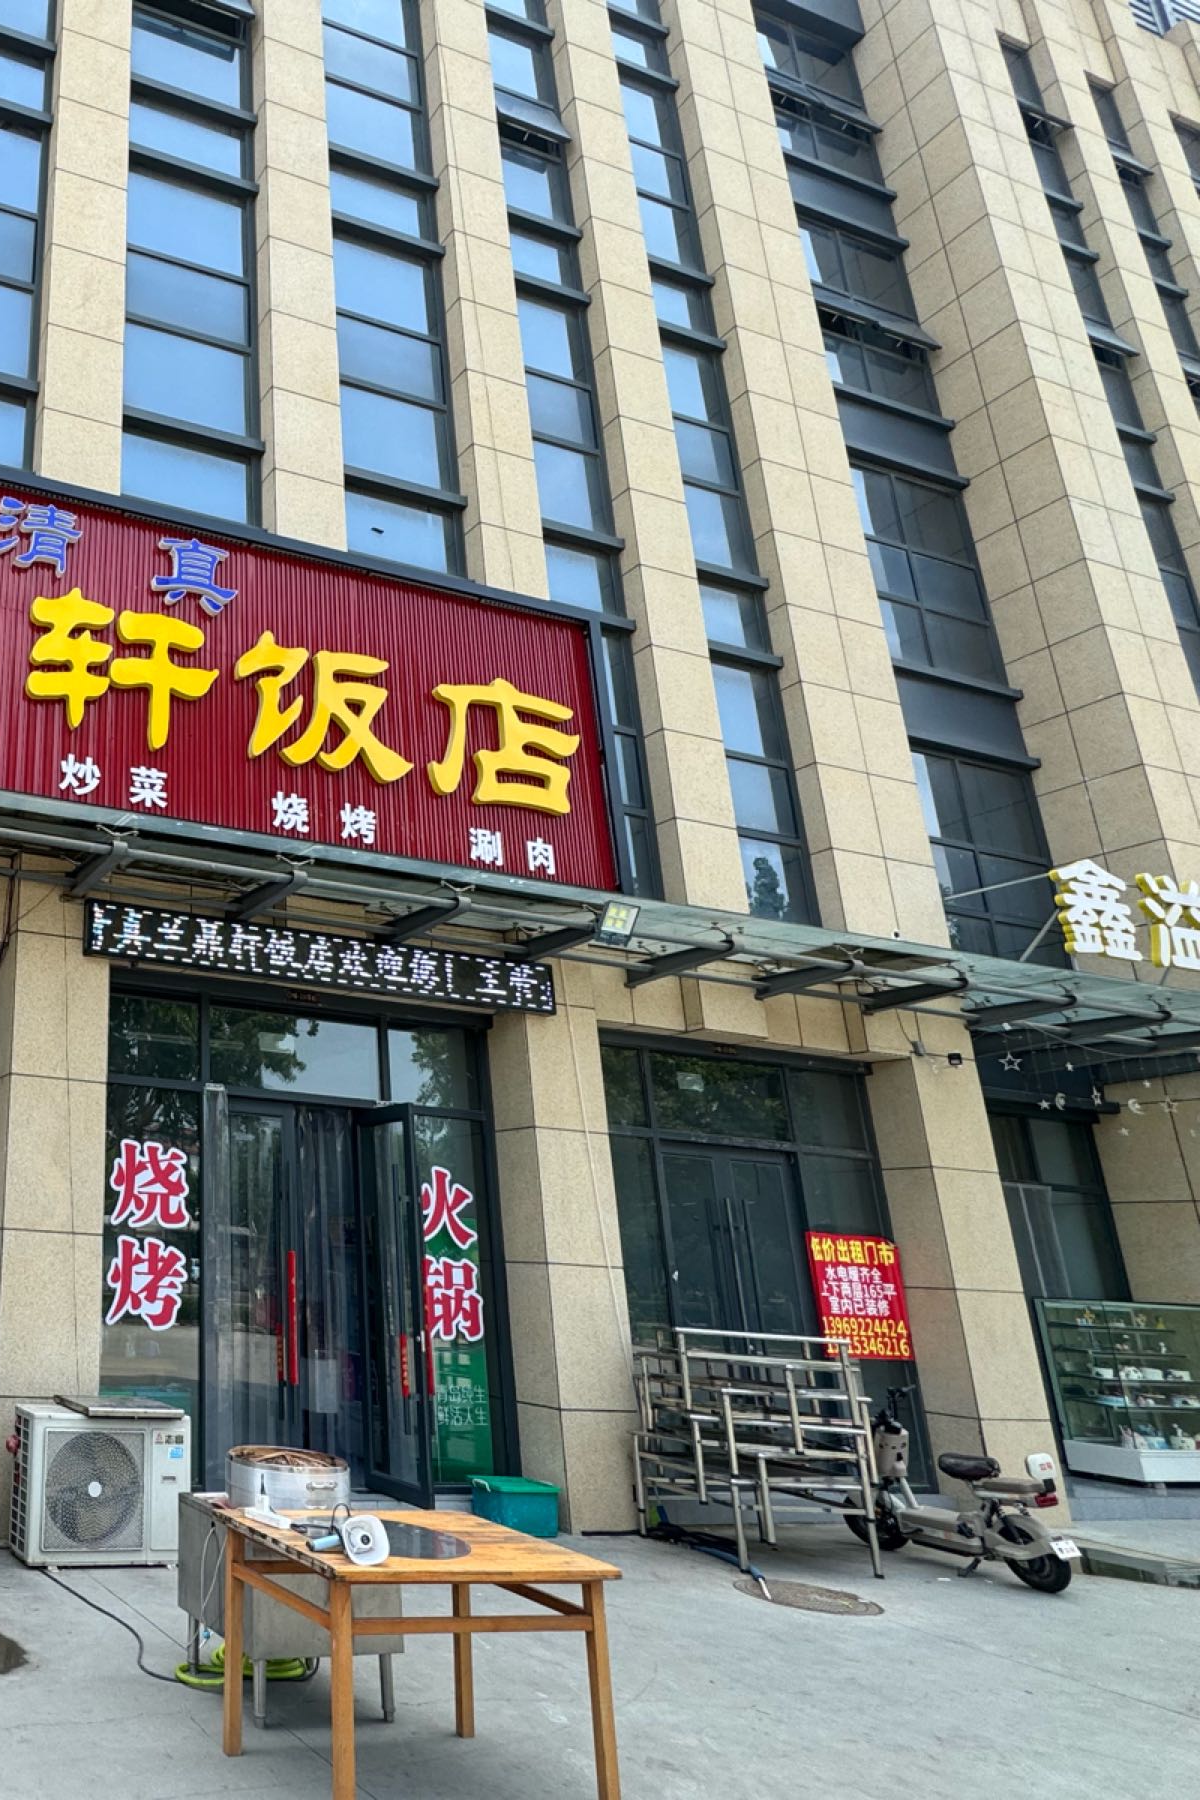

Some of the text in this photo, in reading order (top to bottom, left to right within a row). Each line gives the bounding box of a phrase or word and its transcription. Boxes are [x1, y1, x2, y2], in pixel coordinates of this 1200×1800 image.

[59, 753, 168, 808] 炒菜
[271, 791, 377, 844] 烧烤
[468, 827, 556, 875] 涮肉
[104, 1139, 189, 1331] 烧烤
[420, 1166, 485, 1342] 火锅
[810, 1236, 895, 1266] 低价出租门市
[822, 1316, 907, 1337] 13969224424
